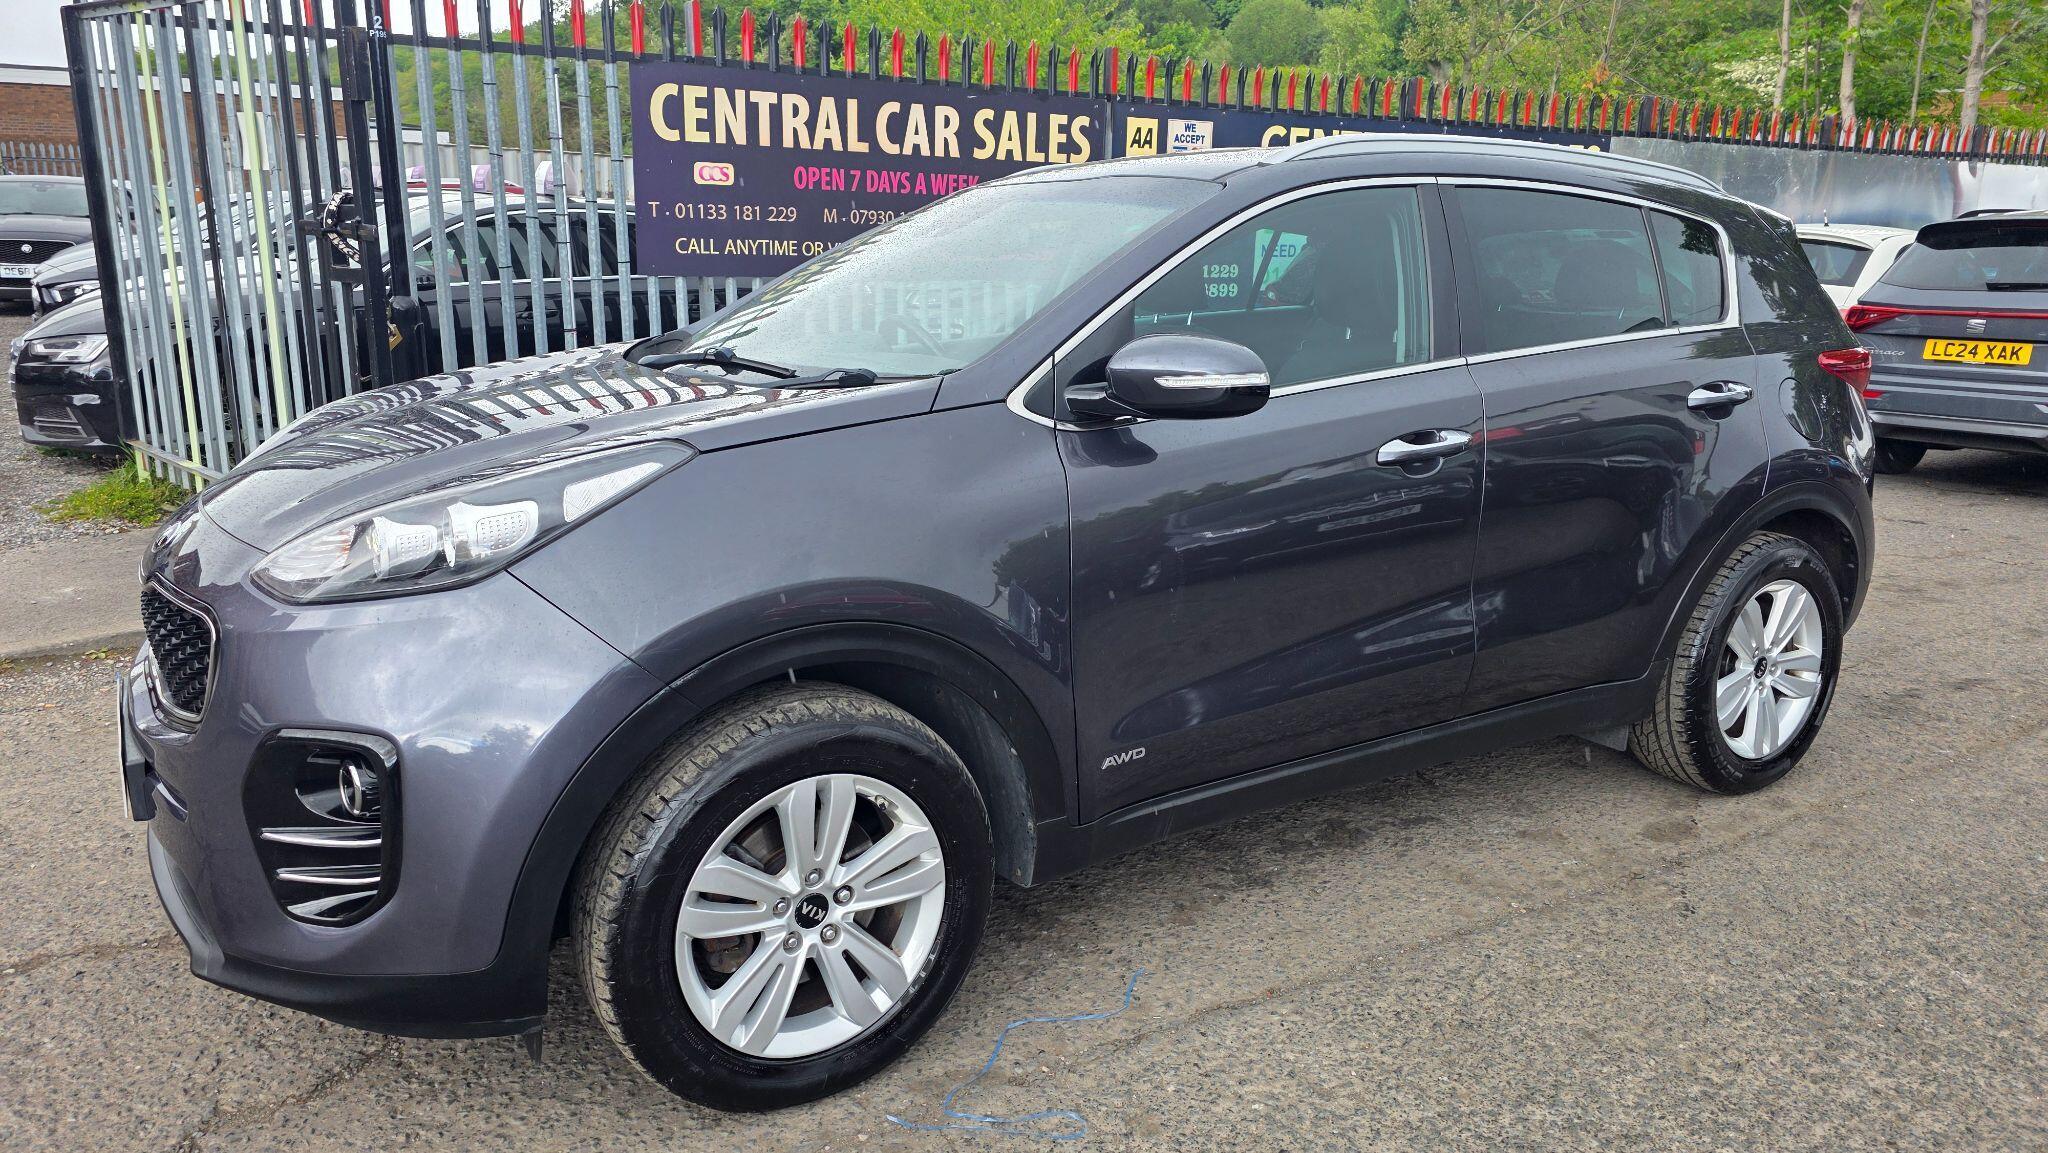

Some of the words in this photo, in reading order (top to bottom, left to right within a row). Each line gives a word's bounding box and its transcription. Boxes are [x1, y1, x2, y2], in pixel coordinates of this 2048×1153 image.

[373, 15, 383, 29] 2
[649, 82, 870, 153] CENTRAL
[875, 101, 961, 159] CAR
[972, 108, 1091, 164] SALES
[1184, 122, 1197, 133] WE
[1129, 127, 1153, 149] AA
[1173, 133, 1206, 145] ACCEPT
[793, 166, 845, 191] OPEN
[850, 170, 861, 192] 7
[866, 170, 911, 194] DAYS
[914, 172, 927, 195] A
[674, 202, 727, 220] 01133
[734, 205, 760, 221] 181
[766, 206, 797, 222] 229
[850, 209, 895, 225] 07930
[675, 237, 720, 254] CALL
[724, 238, 798, 256] ANYTIME
[801, 241, 824, 256] OR
[1931, 341, 1979, 359] LC24
[1984, 344, 2024, 362] XAK
[1101, 747, 1146, 770] AWD
[801, 902, 826, 921] KIA
